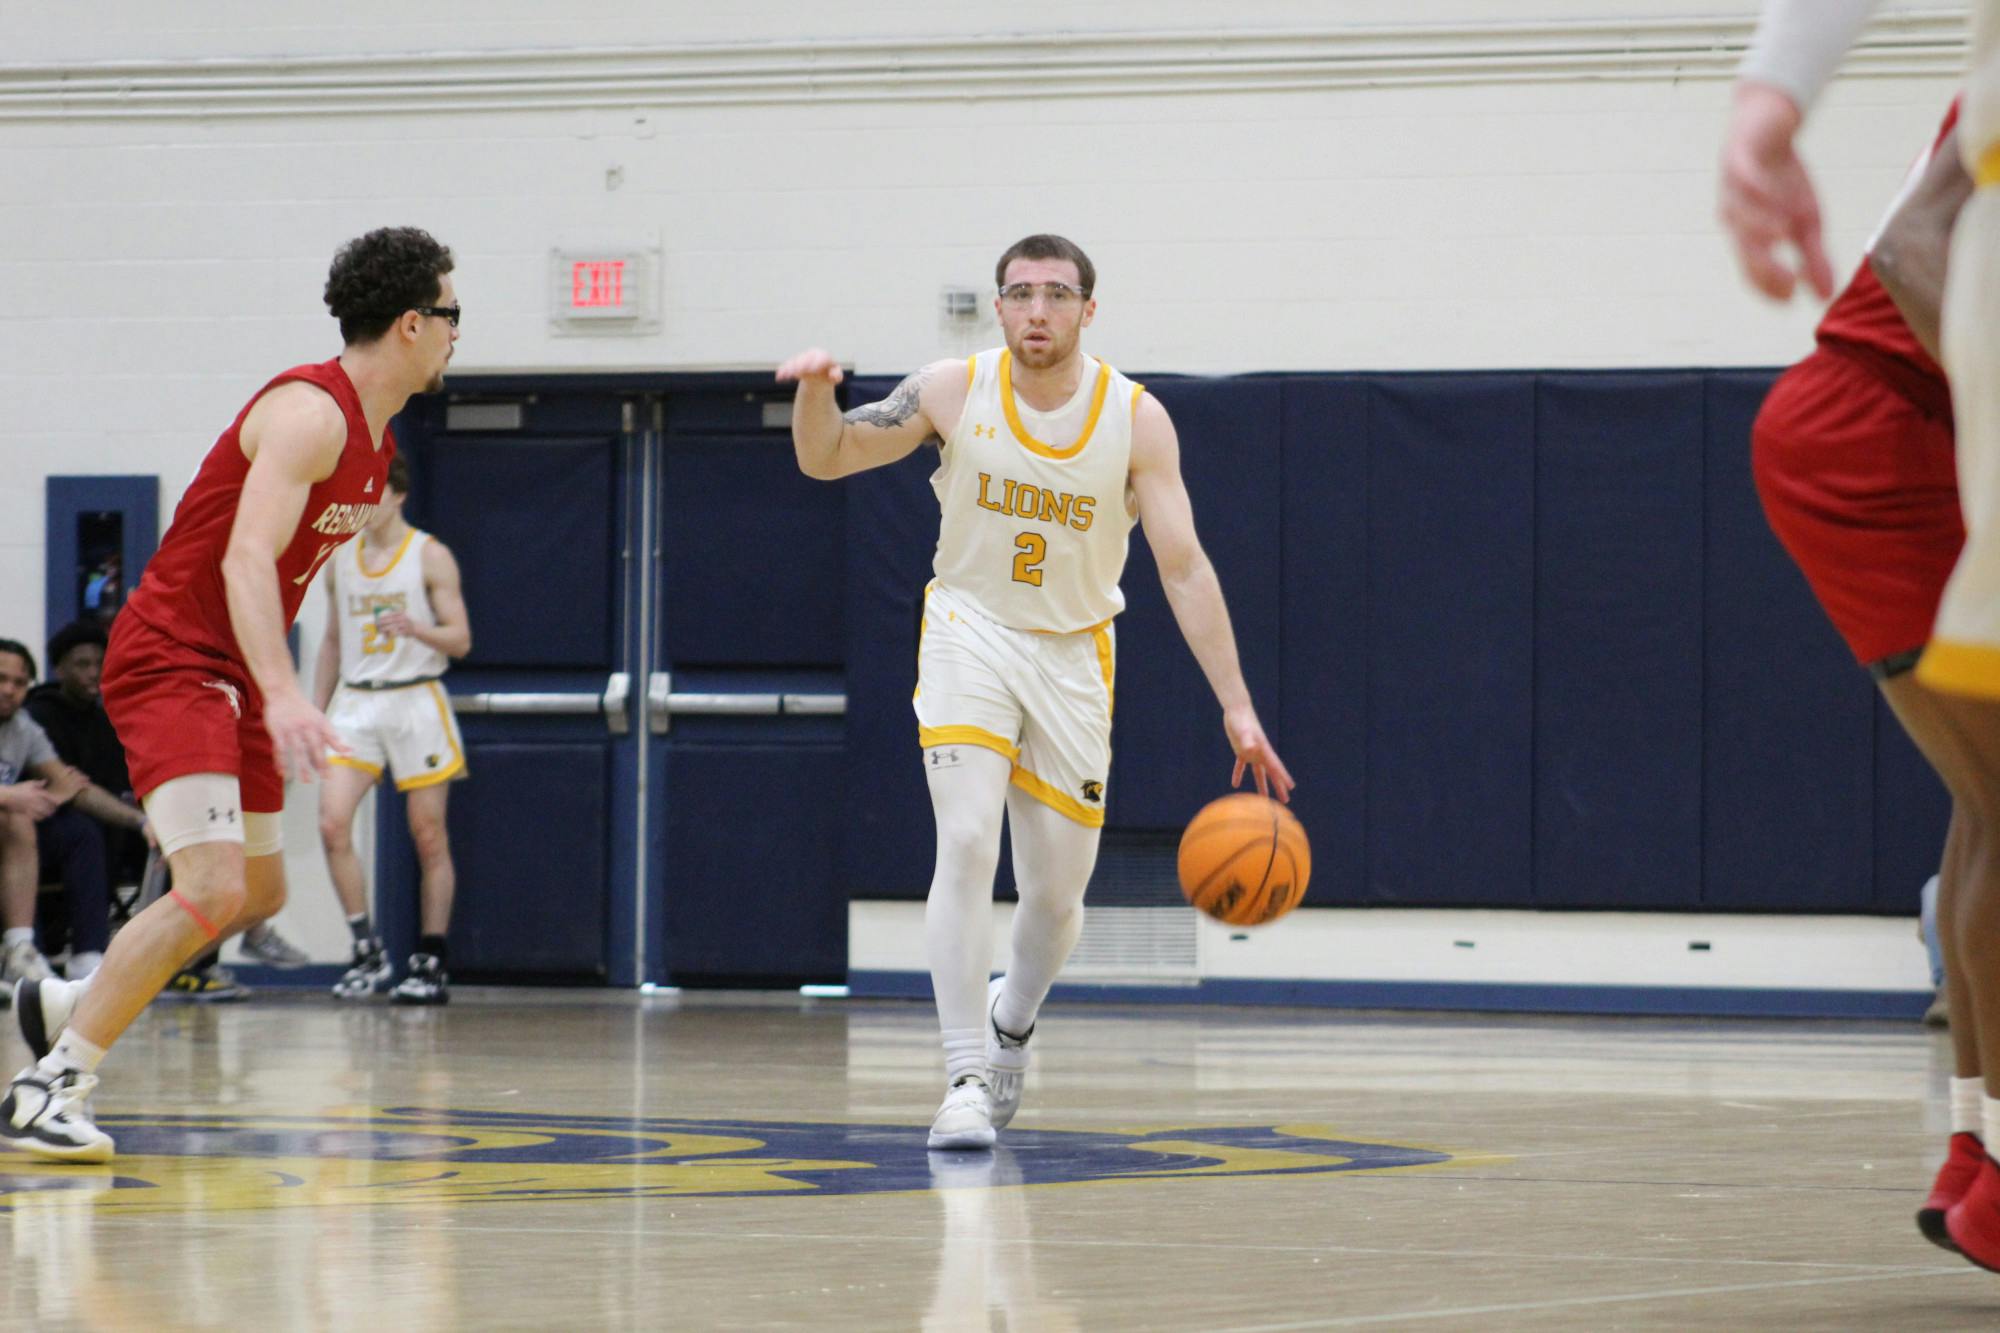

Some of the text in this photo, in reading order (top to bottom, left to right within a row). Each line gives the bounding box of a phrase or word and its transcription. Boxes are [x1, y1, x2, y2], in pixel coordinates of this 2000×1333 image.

[573, 261, 624, 307] EXIT
[977, 472, 1097, 531] LIONS
[1012, 532, 1046, 587] 2
